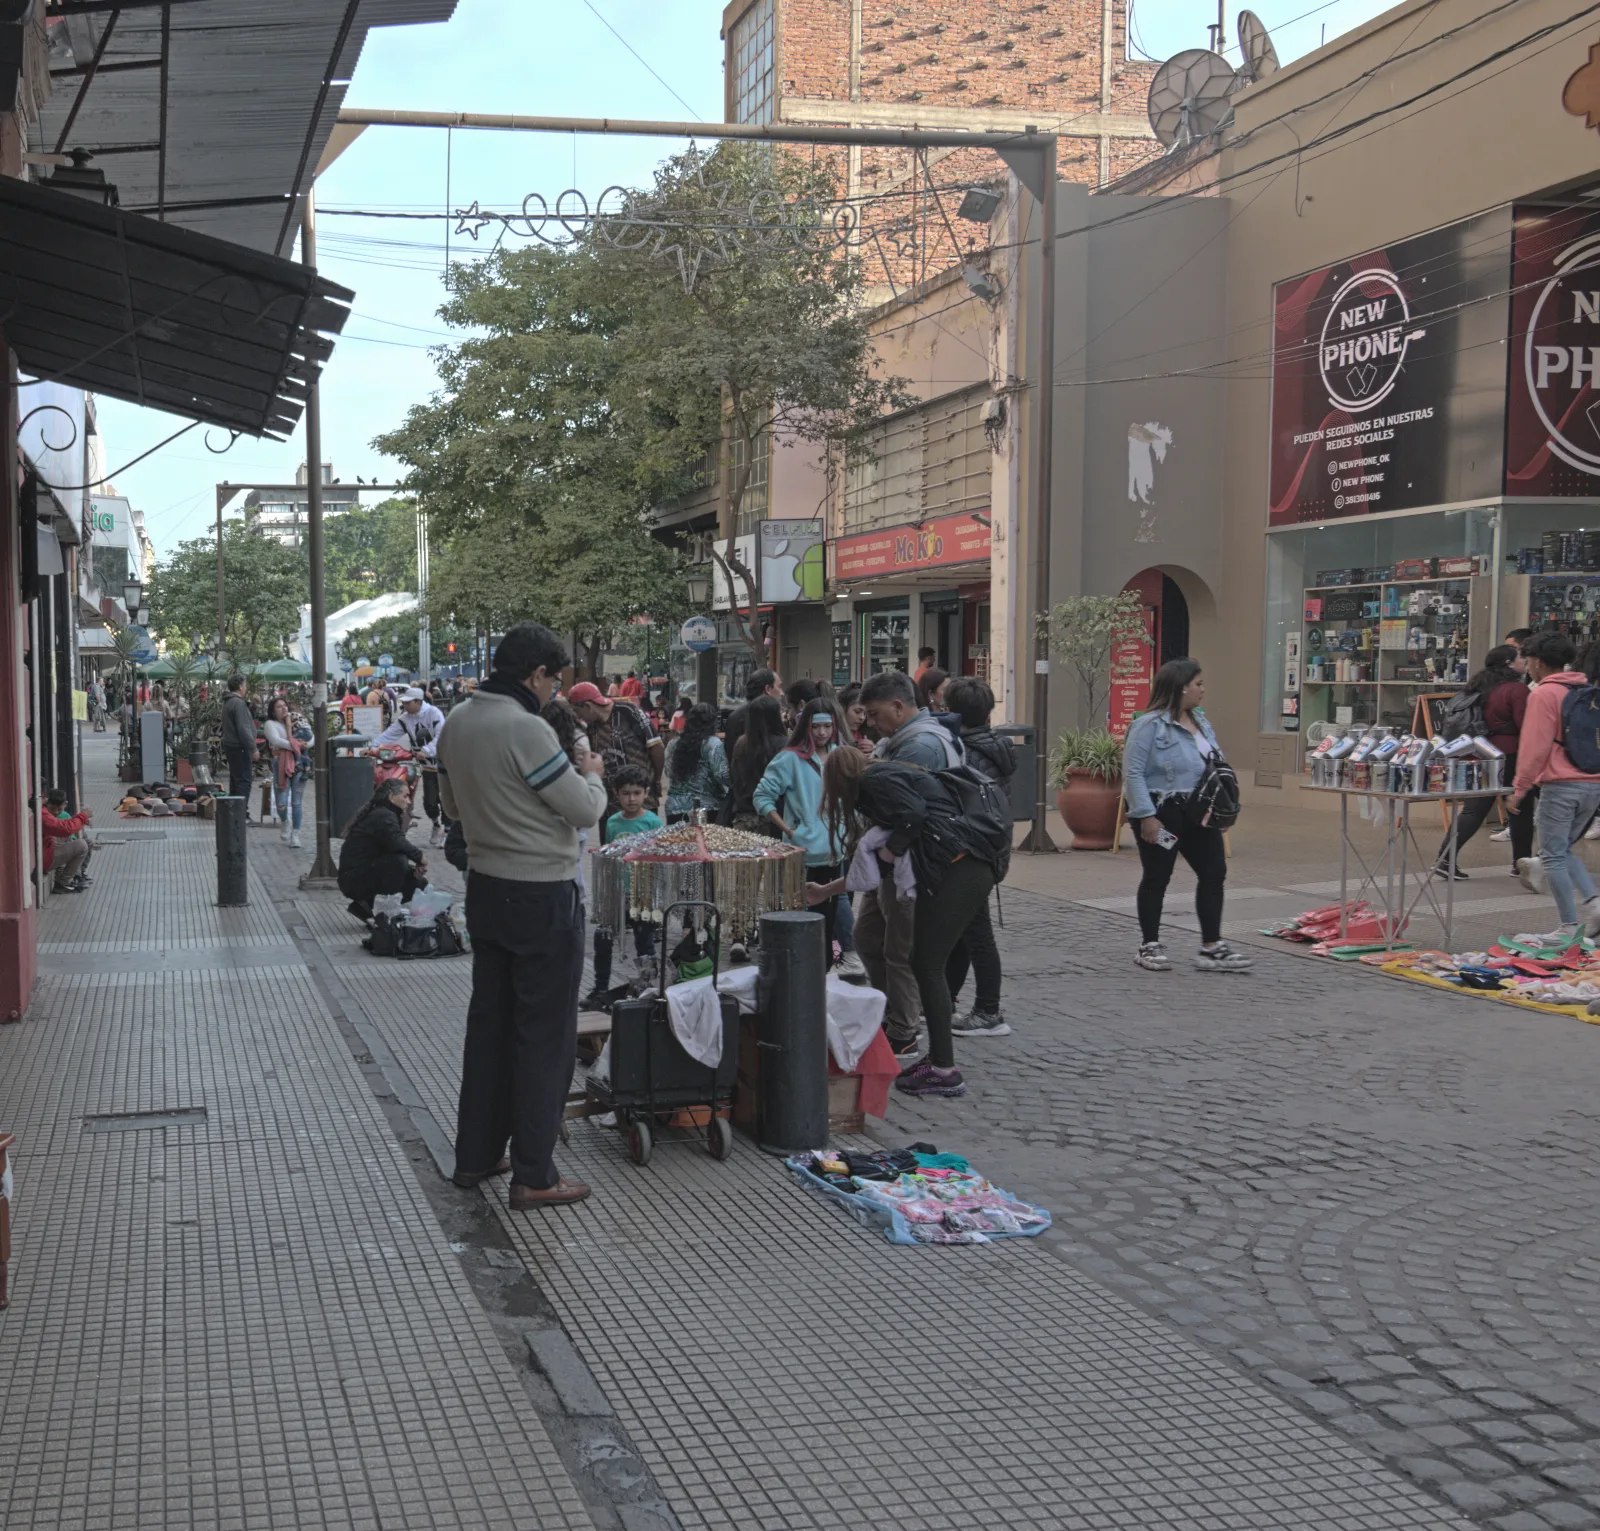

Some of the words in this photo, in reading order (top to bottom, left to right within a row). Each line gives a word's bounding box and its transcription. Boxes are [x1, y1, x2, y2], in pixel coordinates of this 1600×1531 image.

[1340, 299, 1387, 331] NEW
[1323, 326, 1402, 371] PHONE
[1294, 430, 1324, 445] PUEDEN
[1326, 420, 1371, 439] SEGUIRNOS
[1373, 417, 1385, 430] EN
[1387, 407, 1434, 426] NUESTRAS
[1326, 437, 1352, 451] REDES
[1354, 429, 1395, 446] SOCIALES
[1338, 454, 1390, 470] NEWPHONE_OK
[1342, 477, 1358, 488] NEW
[1360, 473, 1385, 485] PHONE
[895, 534, 914, 565] Mc
